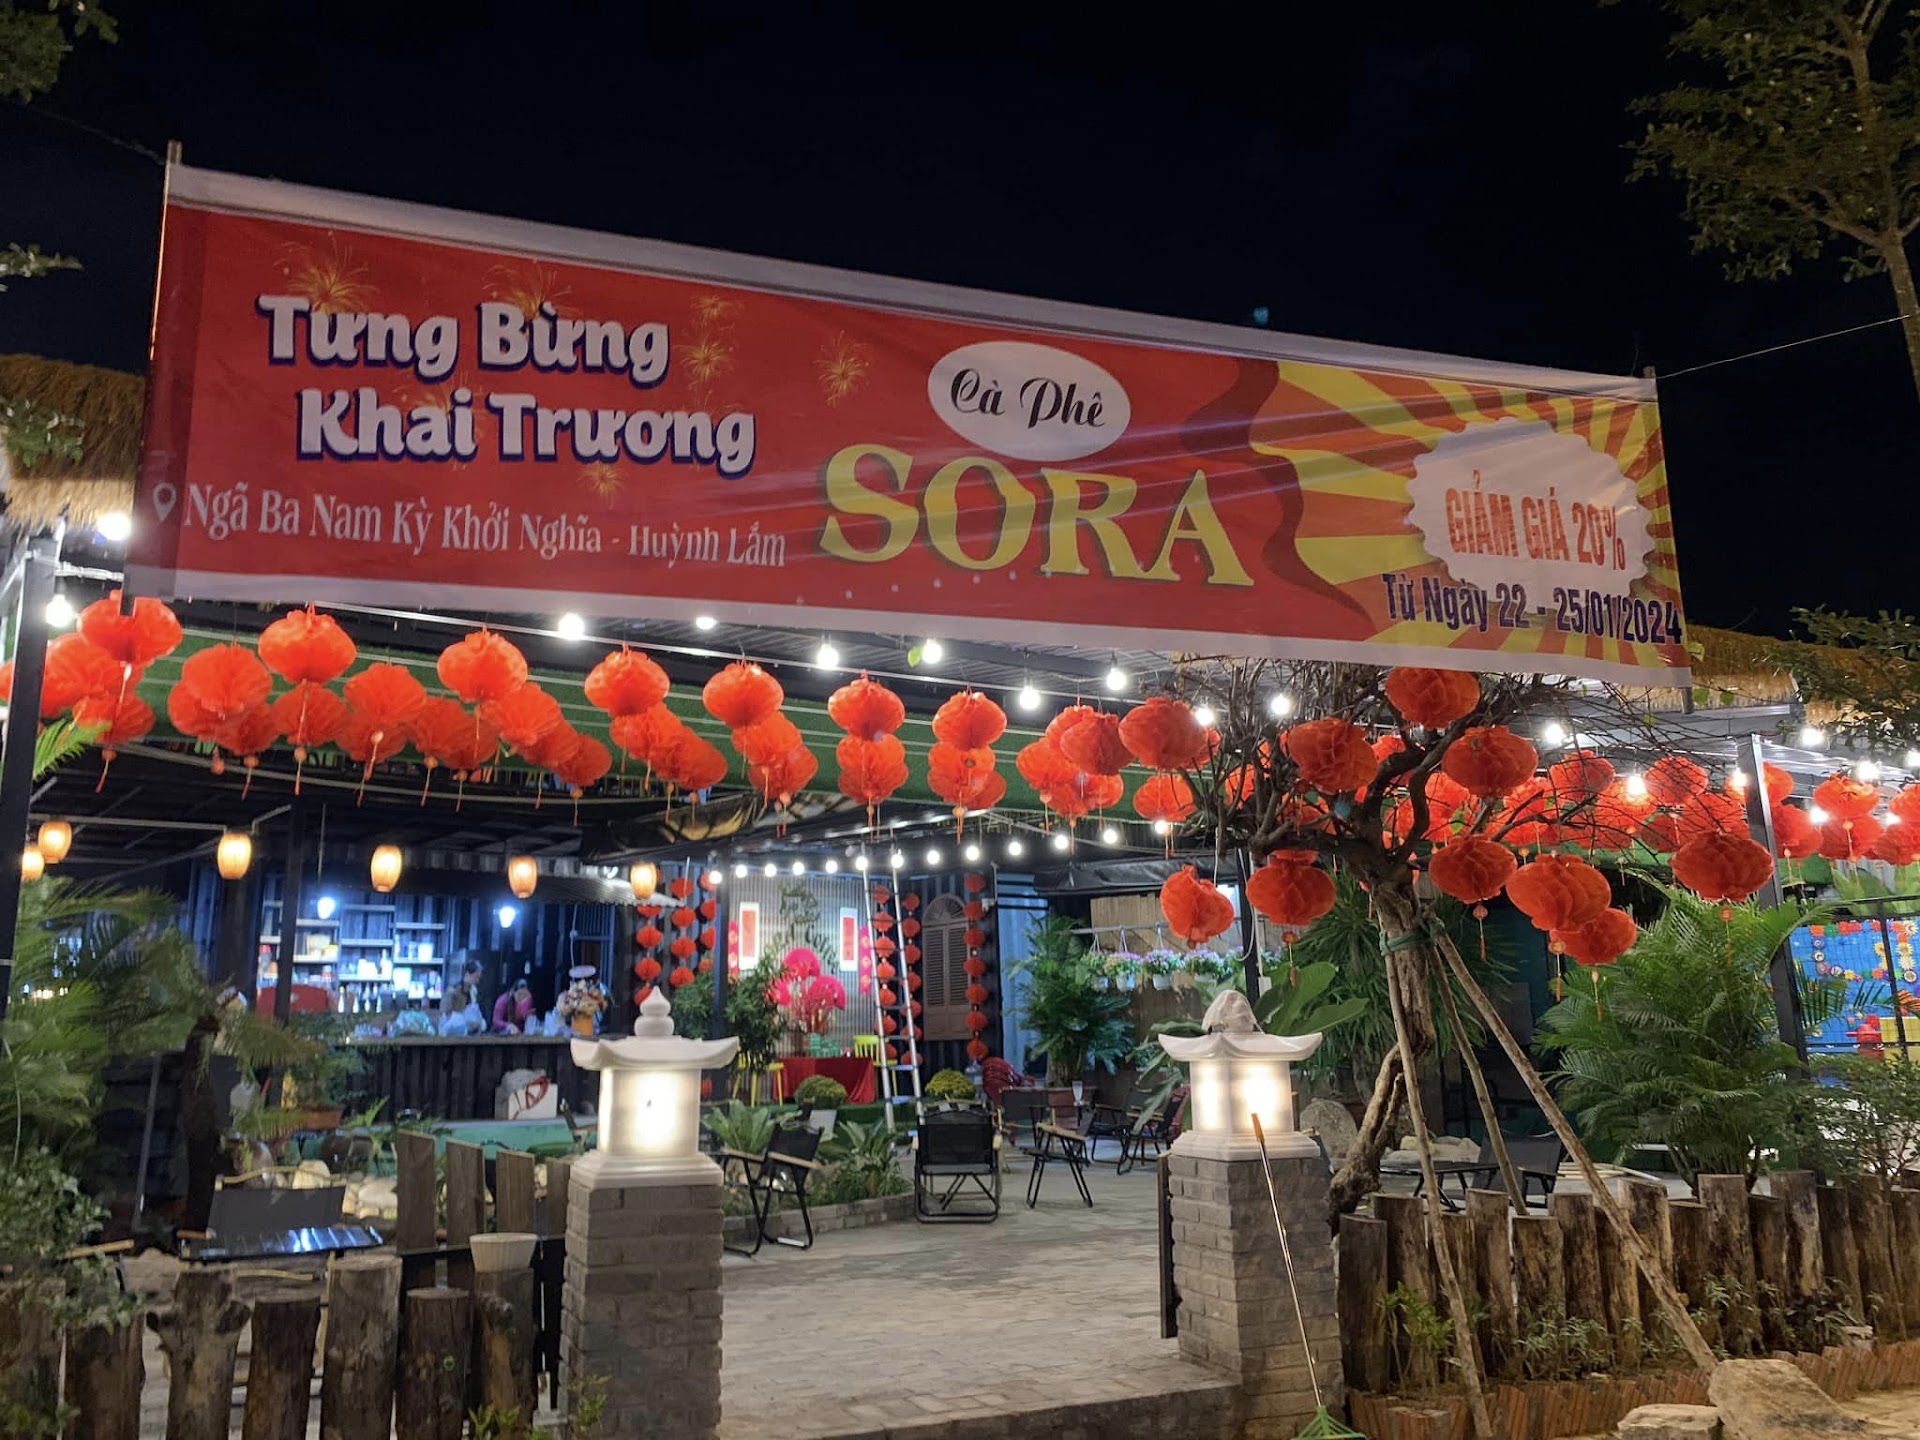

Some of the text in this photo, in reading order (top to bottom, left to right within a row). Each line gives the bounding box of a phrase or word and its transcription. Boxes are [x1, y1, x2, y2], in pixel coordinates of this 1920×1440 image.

[256, 294, 669, 386] Tưng Bừng
[298, 387, 756, 478] Khai Trương
[950, 368, 1106, 429] Cà Phê
[183, 482, 249, 540] Ngã
[258, 489, 301, 535] Ba
[309, 494, 382, 541] Nam
[391, 496, 433, 555] Kỳ
[441, 501, 509, 550] Khởi
[518, 513, 602, 560] Nghĩa
[628, 521, 719, 568] Huỳnh
[819, 443, 1255, 587] SORA
[1445, 469, 1627, 571] GIẢM GIÁ 20%
[1381, 573, 1416, 621] Từ
[1421, 577, 1488, 633] Ngày
[1496, 582, 1531, 629] 22
[1552, 586, 1683, 645] 25/01/2024
